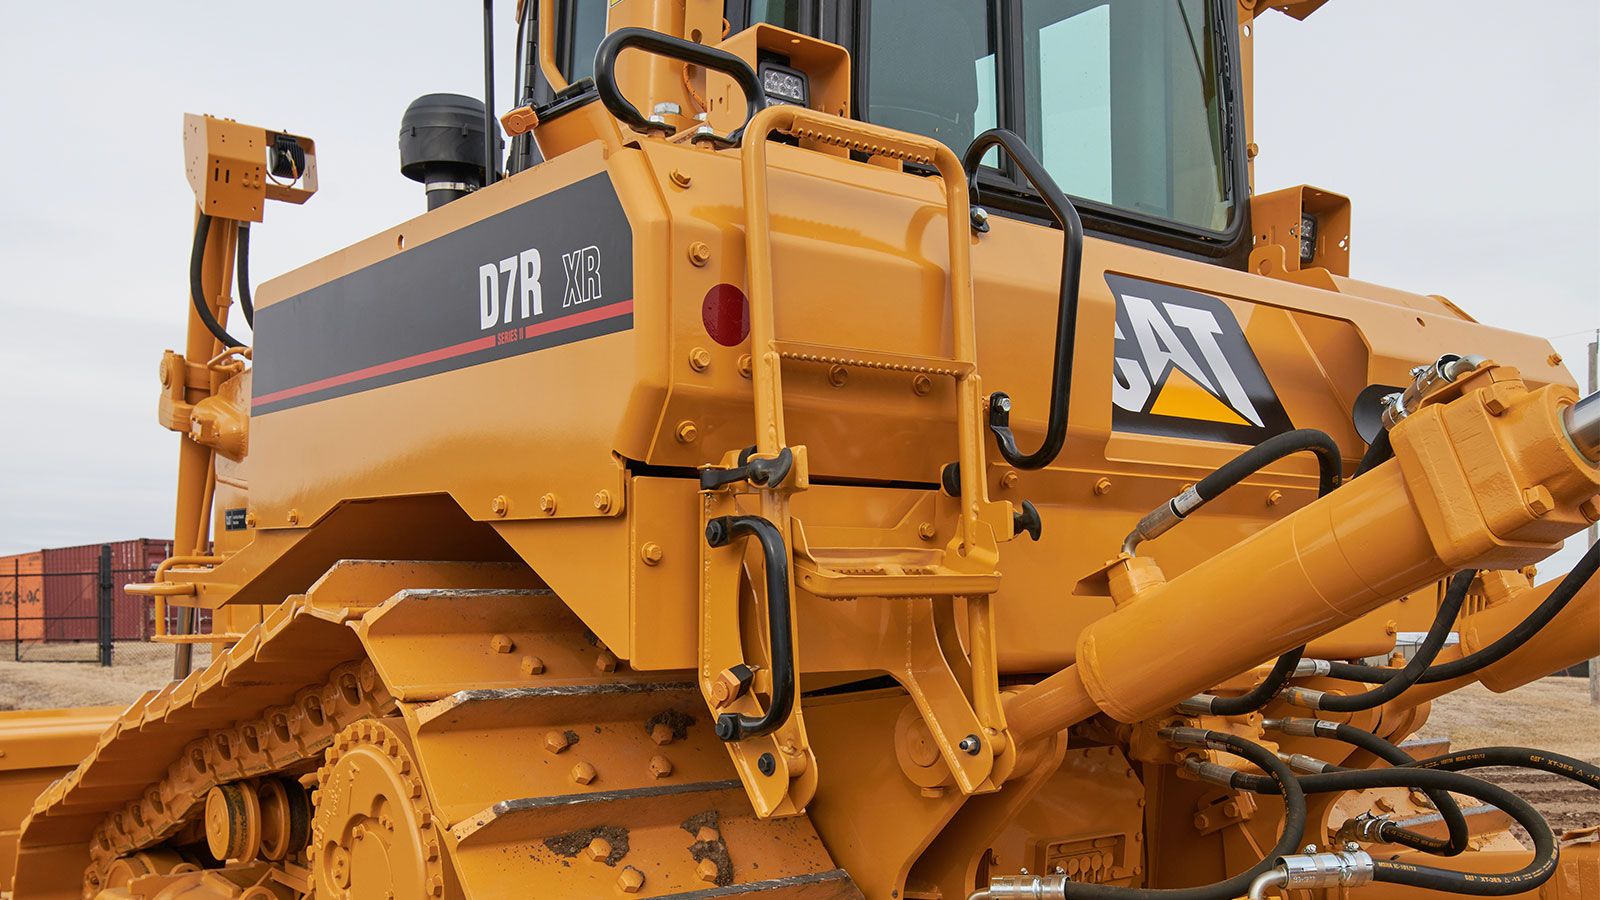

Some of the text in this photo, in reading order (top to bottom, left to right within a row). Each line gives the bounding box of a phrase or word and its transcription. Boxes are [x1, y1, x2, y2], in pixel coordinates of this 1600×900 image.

[479, 245, 602, 330] D7R XR
[497, 328, 524, 345] SERIES II
